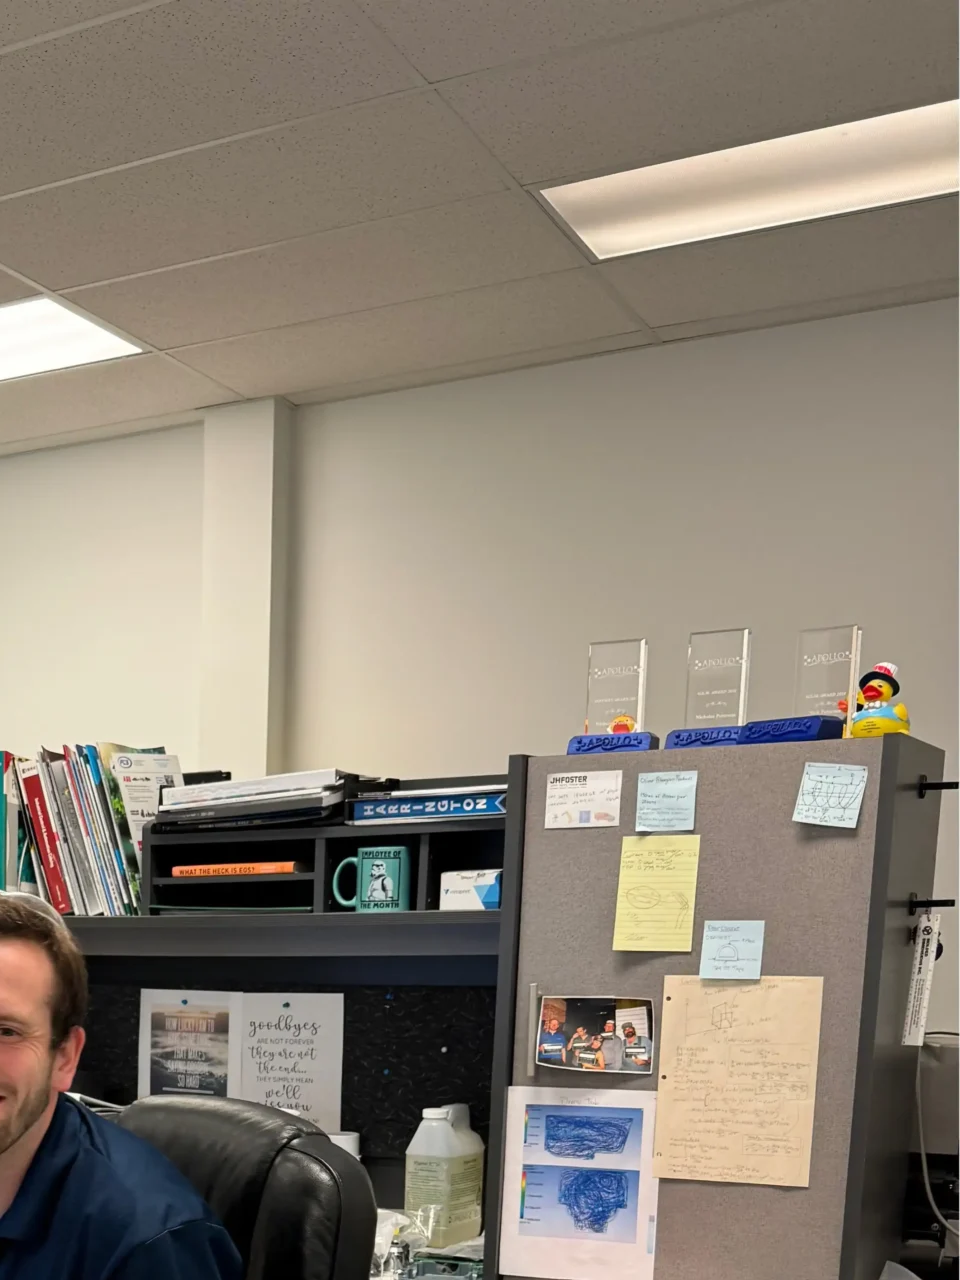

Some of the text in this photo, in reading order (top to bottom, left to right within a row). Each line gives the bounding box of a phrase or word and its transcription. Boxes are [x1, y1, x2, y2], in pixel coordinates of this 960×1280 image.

[703, 657, 735, 667] APOLLO
[811, 652, 845, 663] APOLLO
[602, 666, 634, 675] APOLLO
[587, 736, 633, 747] APOLLO
[683, 729, 733, 743] APOLLO
[550, 775, 587, 784] JHFOSTER
[364, 798, 487, 816] HARRINGTON
[362, 850, 401, 858] EMPLOYEE OF
[248, 1014, 321, 1037] goodbyes
[248, 1046, 317, 1061] they are not
[256, 1060, 277, 1074] the
[177, 1075, 186, 1088] SO
[265, 1084, 303, 1100] we'll
